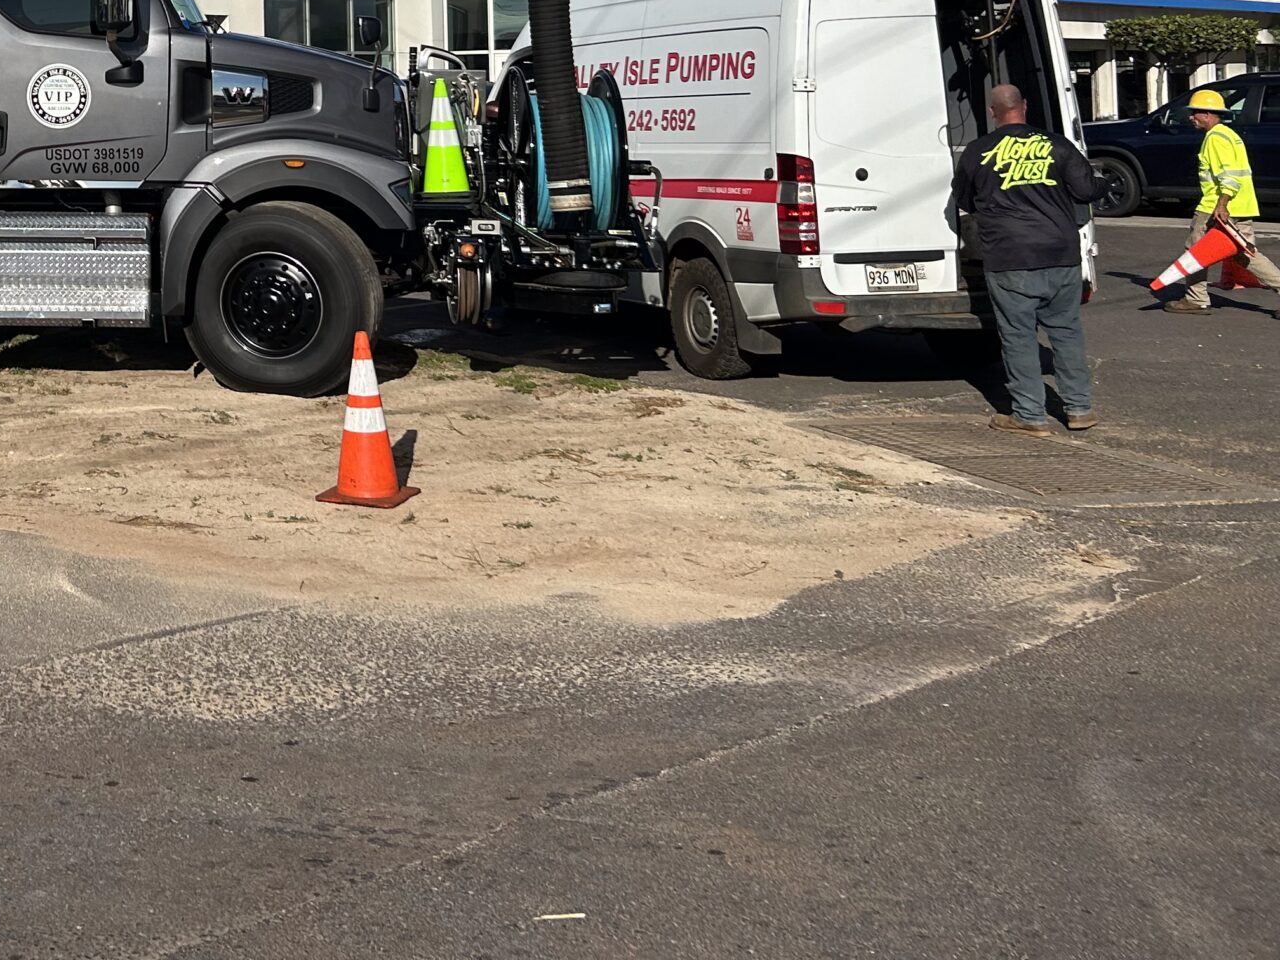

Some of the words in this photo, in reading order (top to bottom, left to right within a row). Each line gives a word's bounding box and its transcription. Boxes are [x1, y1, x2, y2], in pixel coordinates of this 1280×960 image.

[665, 50, 756, 84] PUMPING
[44, 91, 73, 102] VIP
[45, 148, 90, 161] USDOT
[93, 147, 144, 160] 3981519
[980, 134, 1053, 171] Aloha
[50, 162, 87, 174] GVW
[92, 161, 140, 175] 68,000
[999, 156, 1057, 190] First
[735, 207, 752, 226] 24
[823, 205, 878, 213] SPRINTER
[868, 270, 889, 285] 936
[894, 269, 915, 284] MDN
